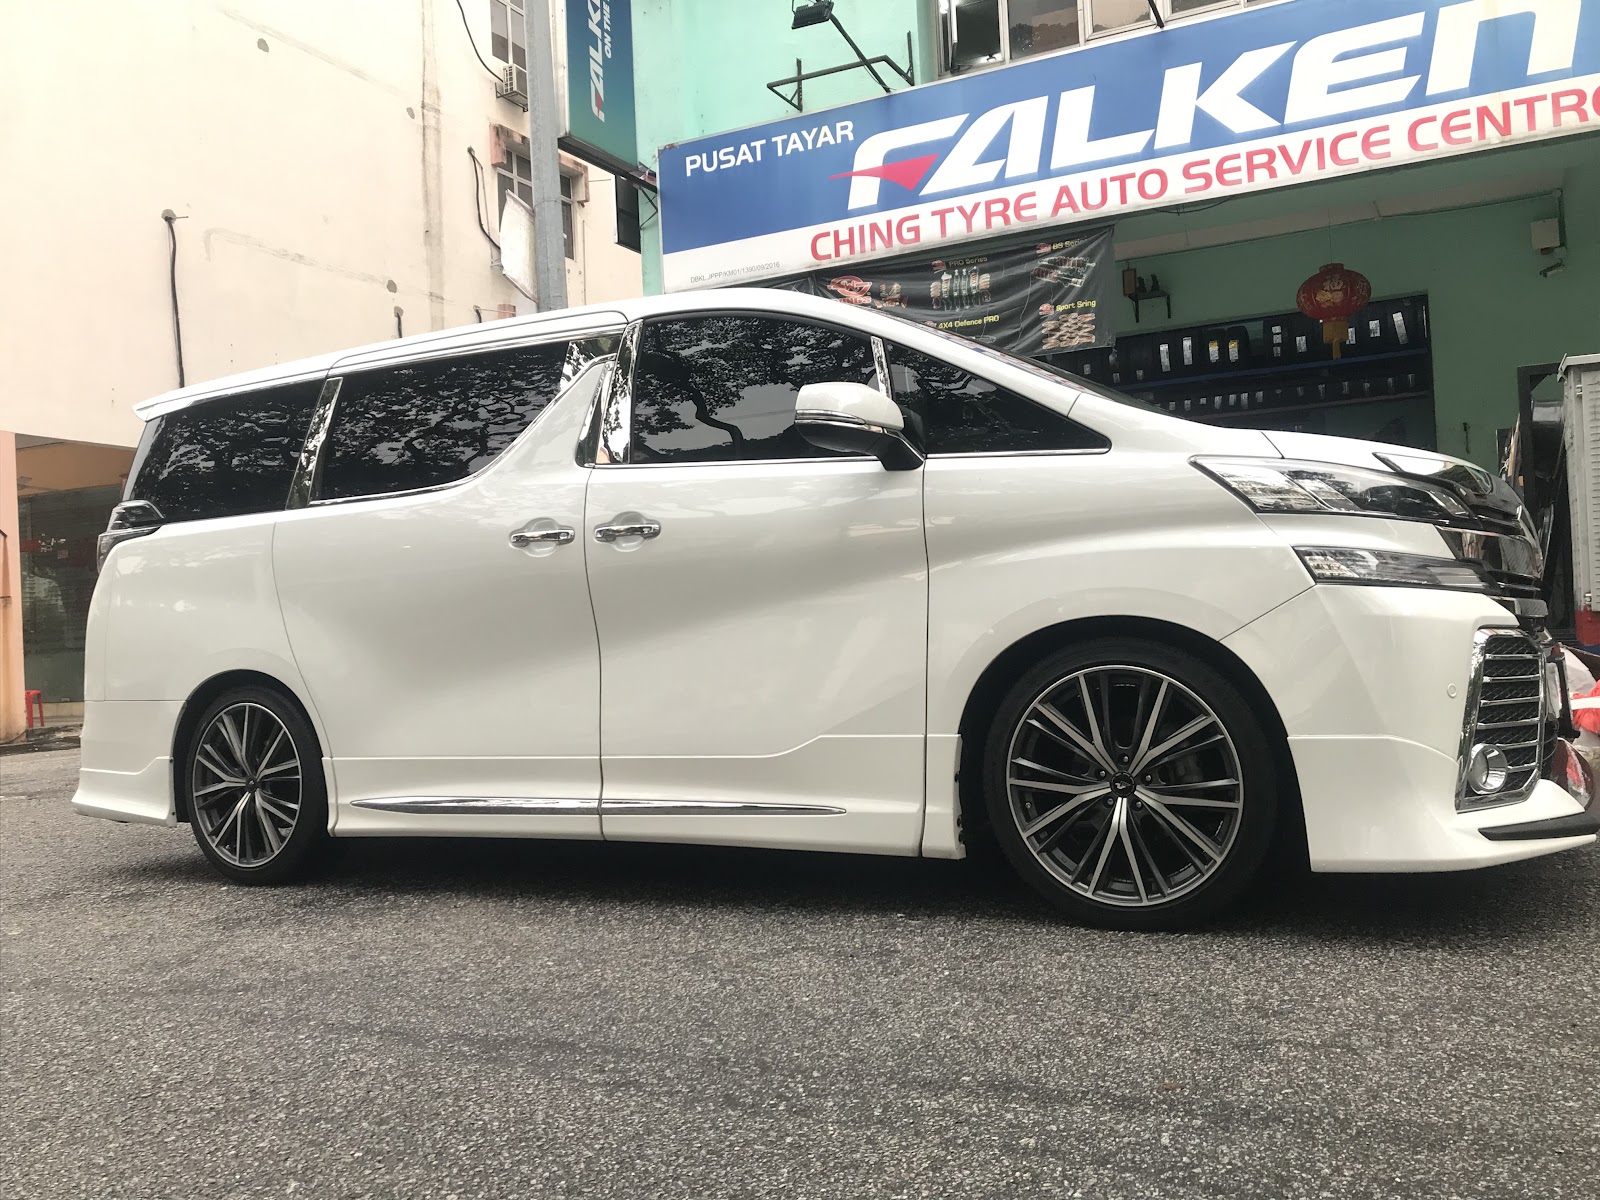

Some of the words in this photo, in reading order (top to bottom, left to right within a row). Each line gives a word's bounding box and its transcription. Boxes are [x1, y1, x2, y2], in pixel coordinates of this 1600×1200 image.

[602, 1, 611, 31] THE
[604, 31, 612, 58] ON
[685, 139, 766, 176] PUSAT
[772, 120, 854, 157] TAYAR
[810, 213, 921, 261] CHING
[931, 191, 1037, 239] TYRE
[1050, 168, 1169, 217] AUTO
[1182, 124, 1391, 194] SERVICE
[1407, 84, 1600, 152] CENTR
[1055, 302, 1076, 312] Sport
[1076, 299, 1097, 308] Sring
[938, 321, 953, 329] 4X4
[954, 318, 983, 327] Defence
[983, 314, 1000, 323] PRO
